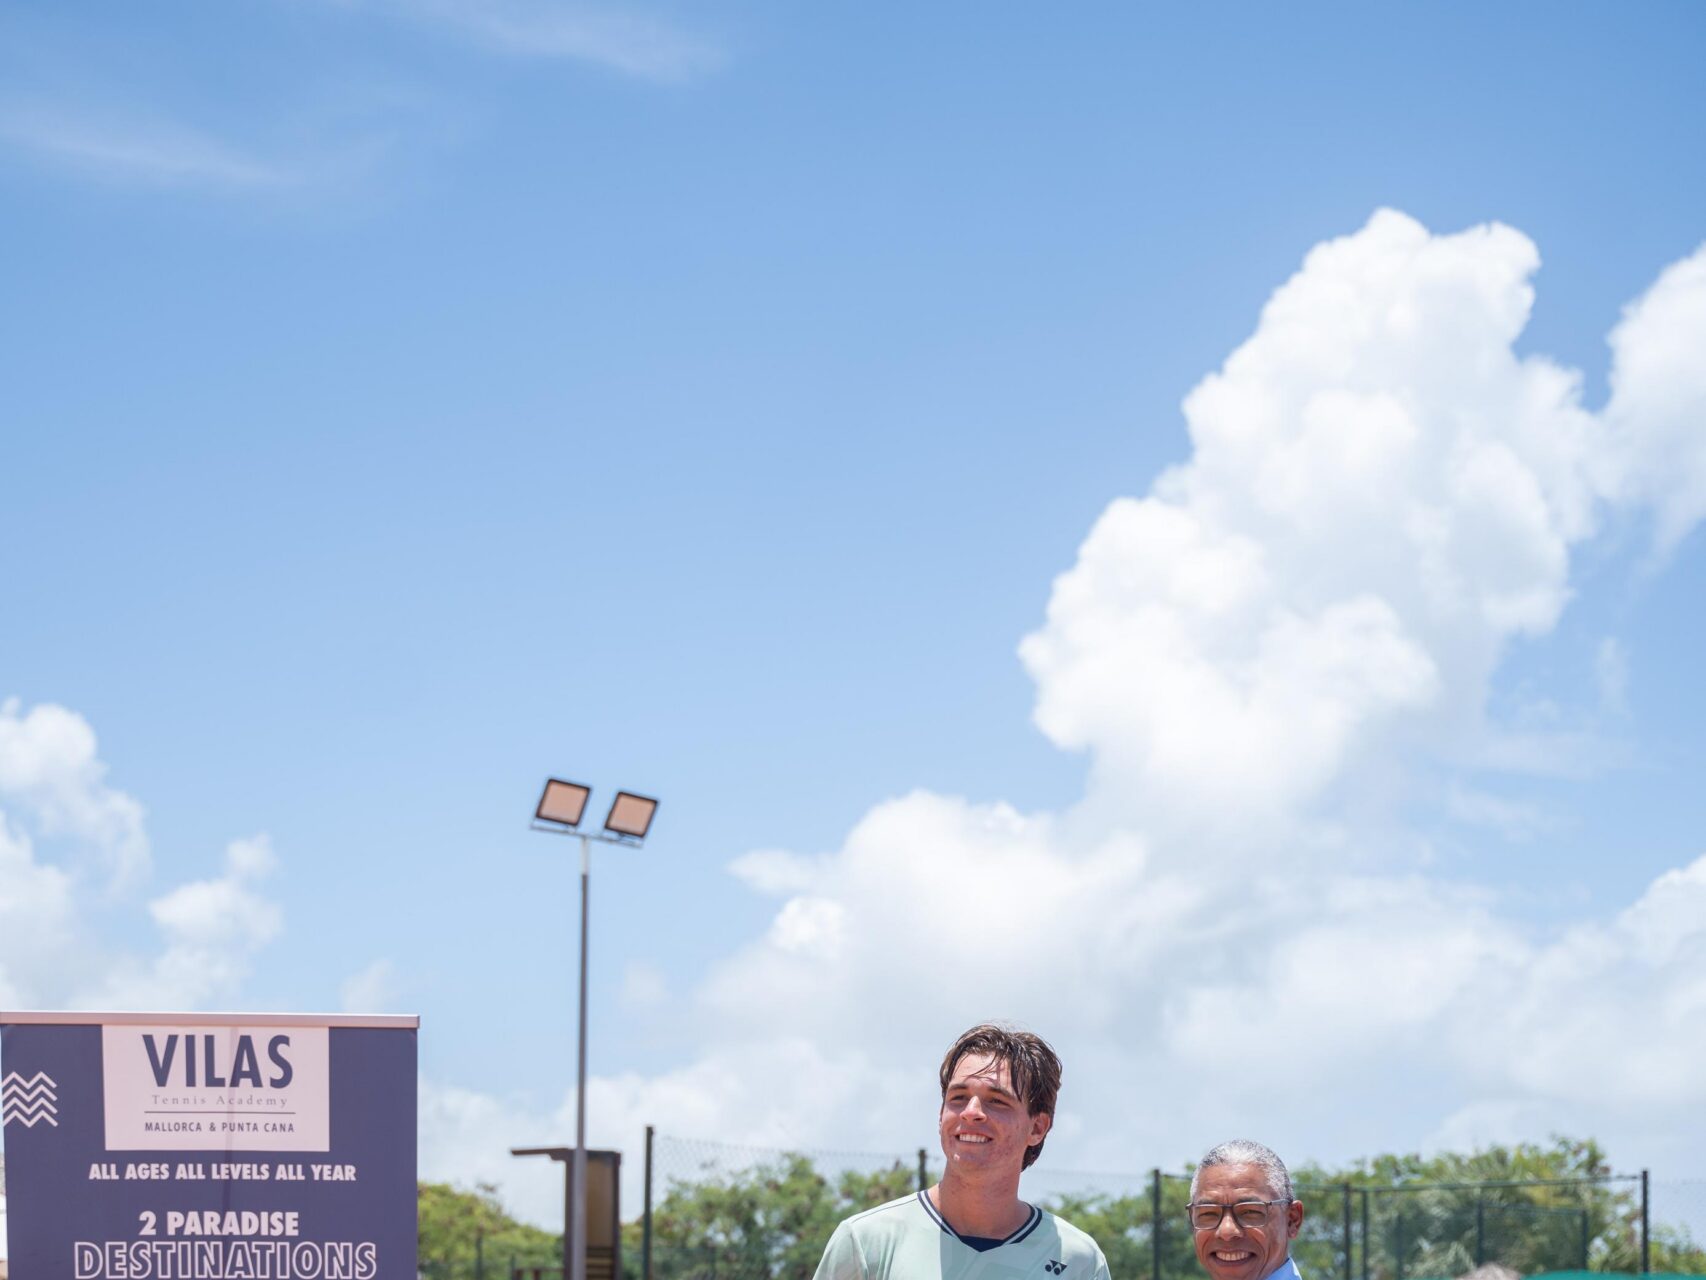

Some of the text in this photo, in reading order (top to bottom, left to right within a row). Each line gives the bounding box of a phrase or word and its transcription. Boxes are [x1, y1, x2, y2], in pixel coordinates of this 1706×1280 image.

[142, 1034, 293, 1089] VILAS
[152, 1095, 288, 1108] Tennis Academy
[144, 1122, 295, 1133] MALLORCA & PUNTA CANA
[89, 1163, 356, 1181] ALL AGES ALL LEVELS ALL YEAR
[138, 1211, 299, 1236] 2 PARADISE
[74, 1241, 377, 1280] DESTINATIONS
